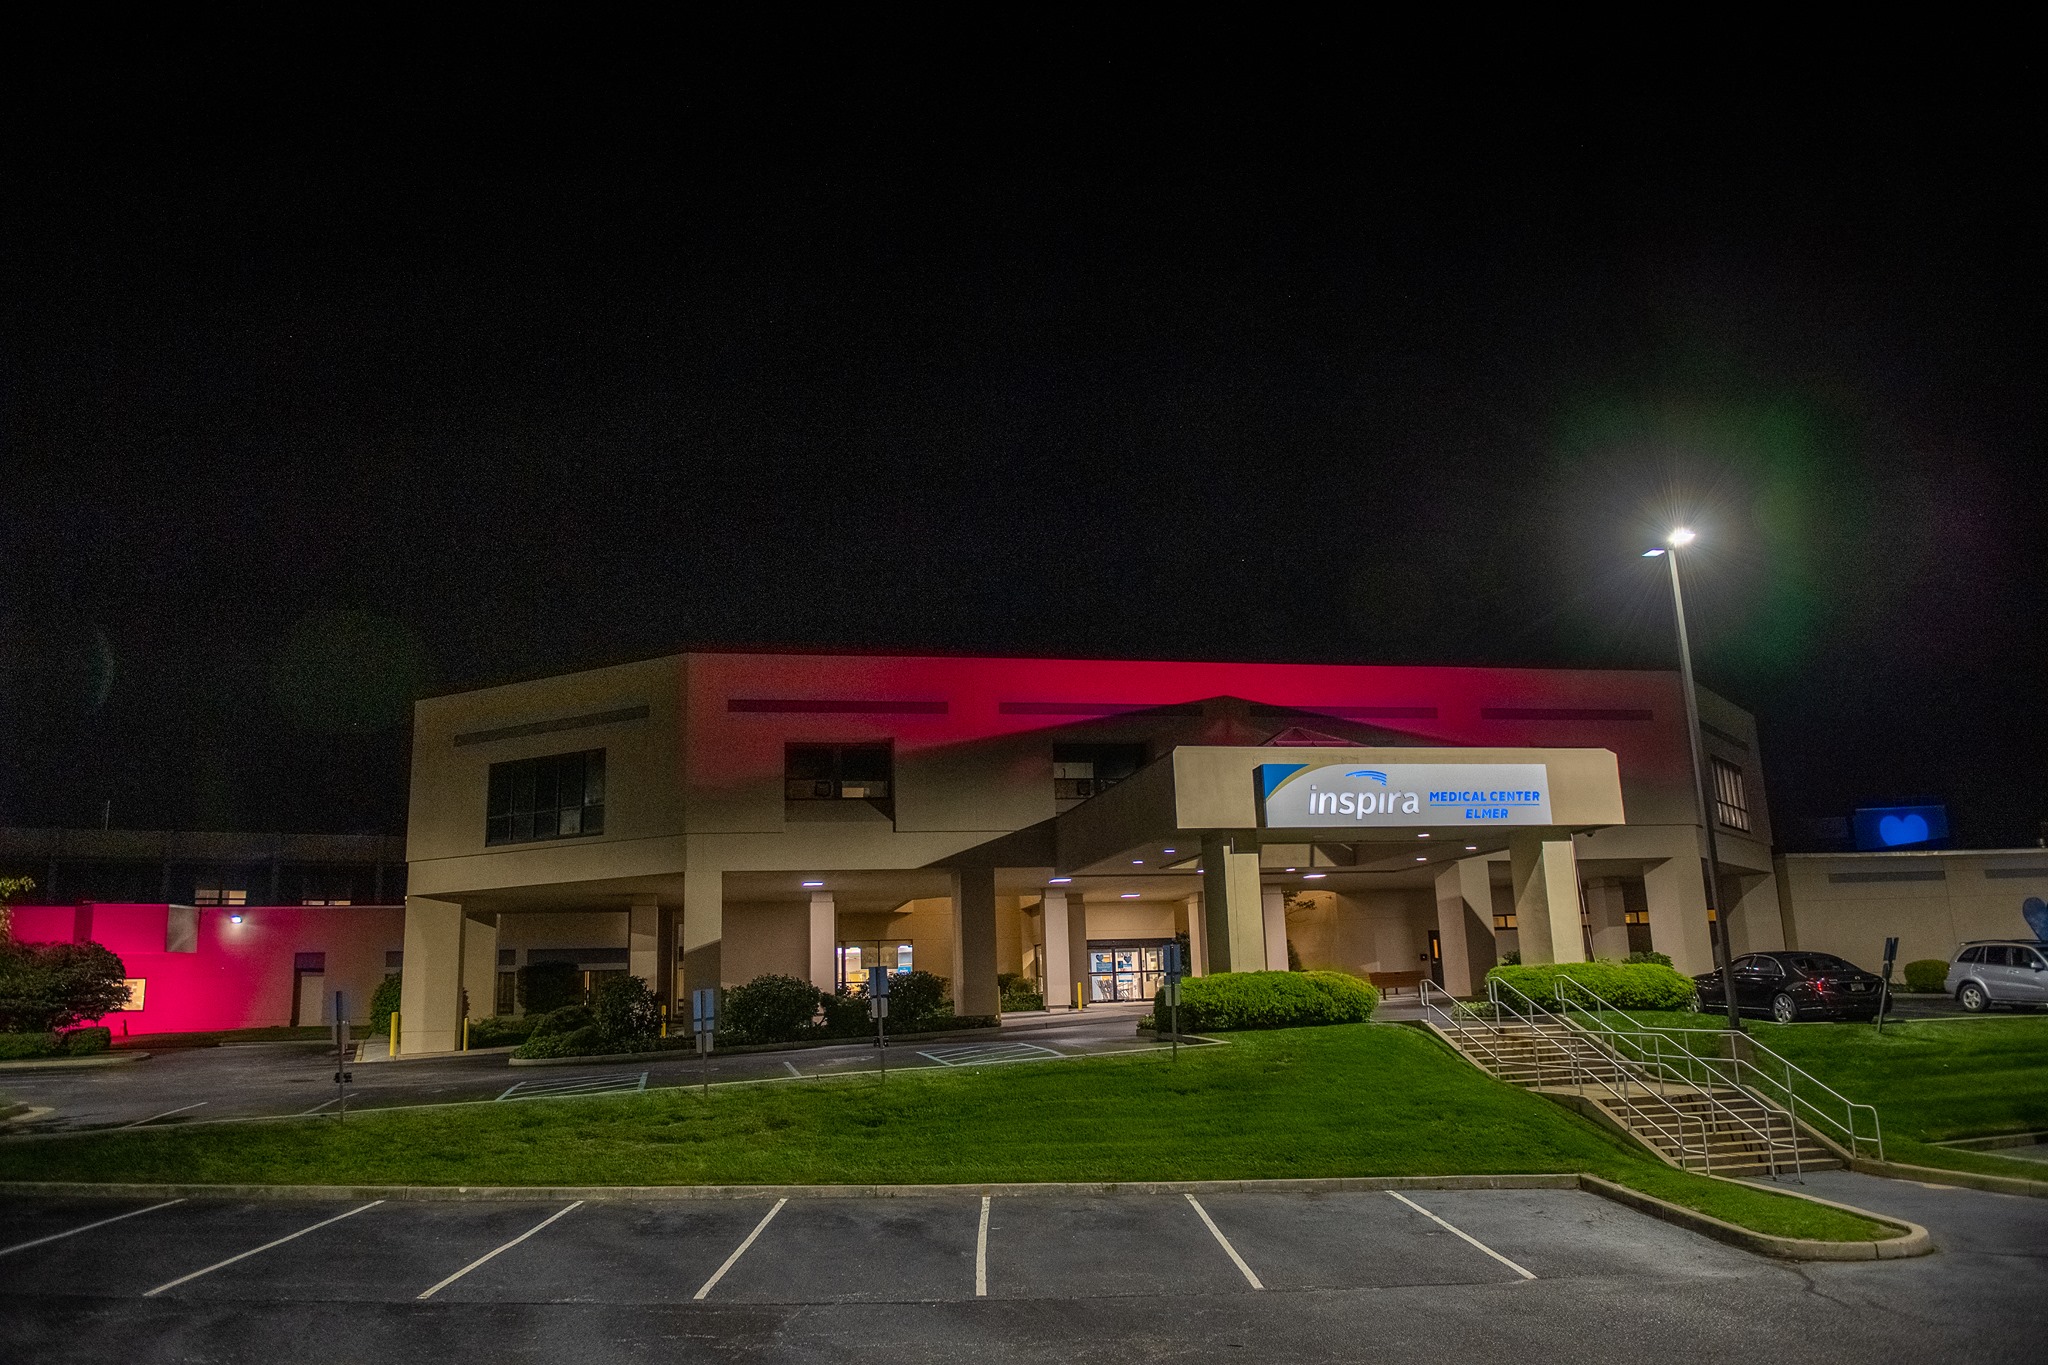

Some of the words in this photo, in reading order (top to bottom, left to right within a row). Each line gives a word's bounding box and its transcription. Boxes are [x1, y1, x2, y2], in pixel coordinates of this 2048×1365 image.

[1309, 784, 1420, 820] inspira
[1429, 791, 1487, 802] MEDICAL
[1489, 790, 1541, 802] CENTER
[1465, 808, 1509, 819] ELMER
